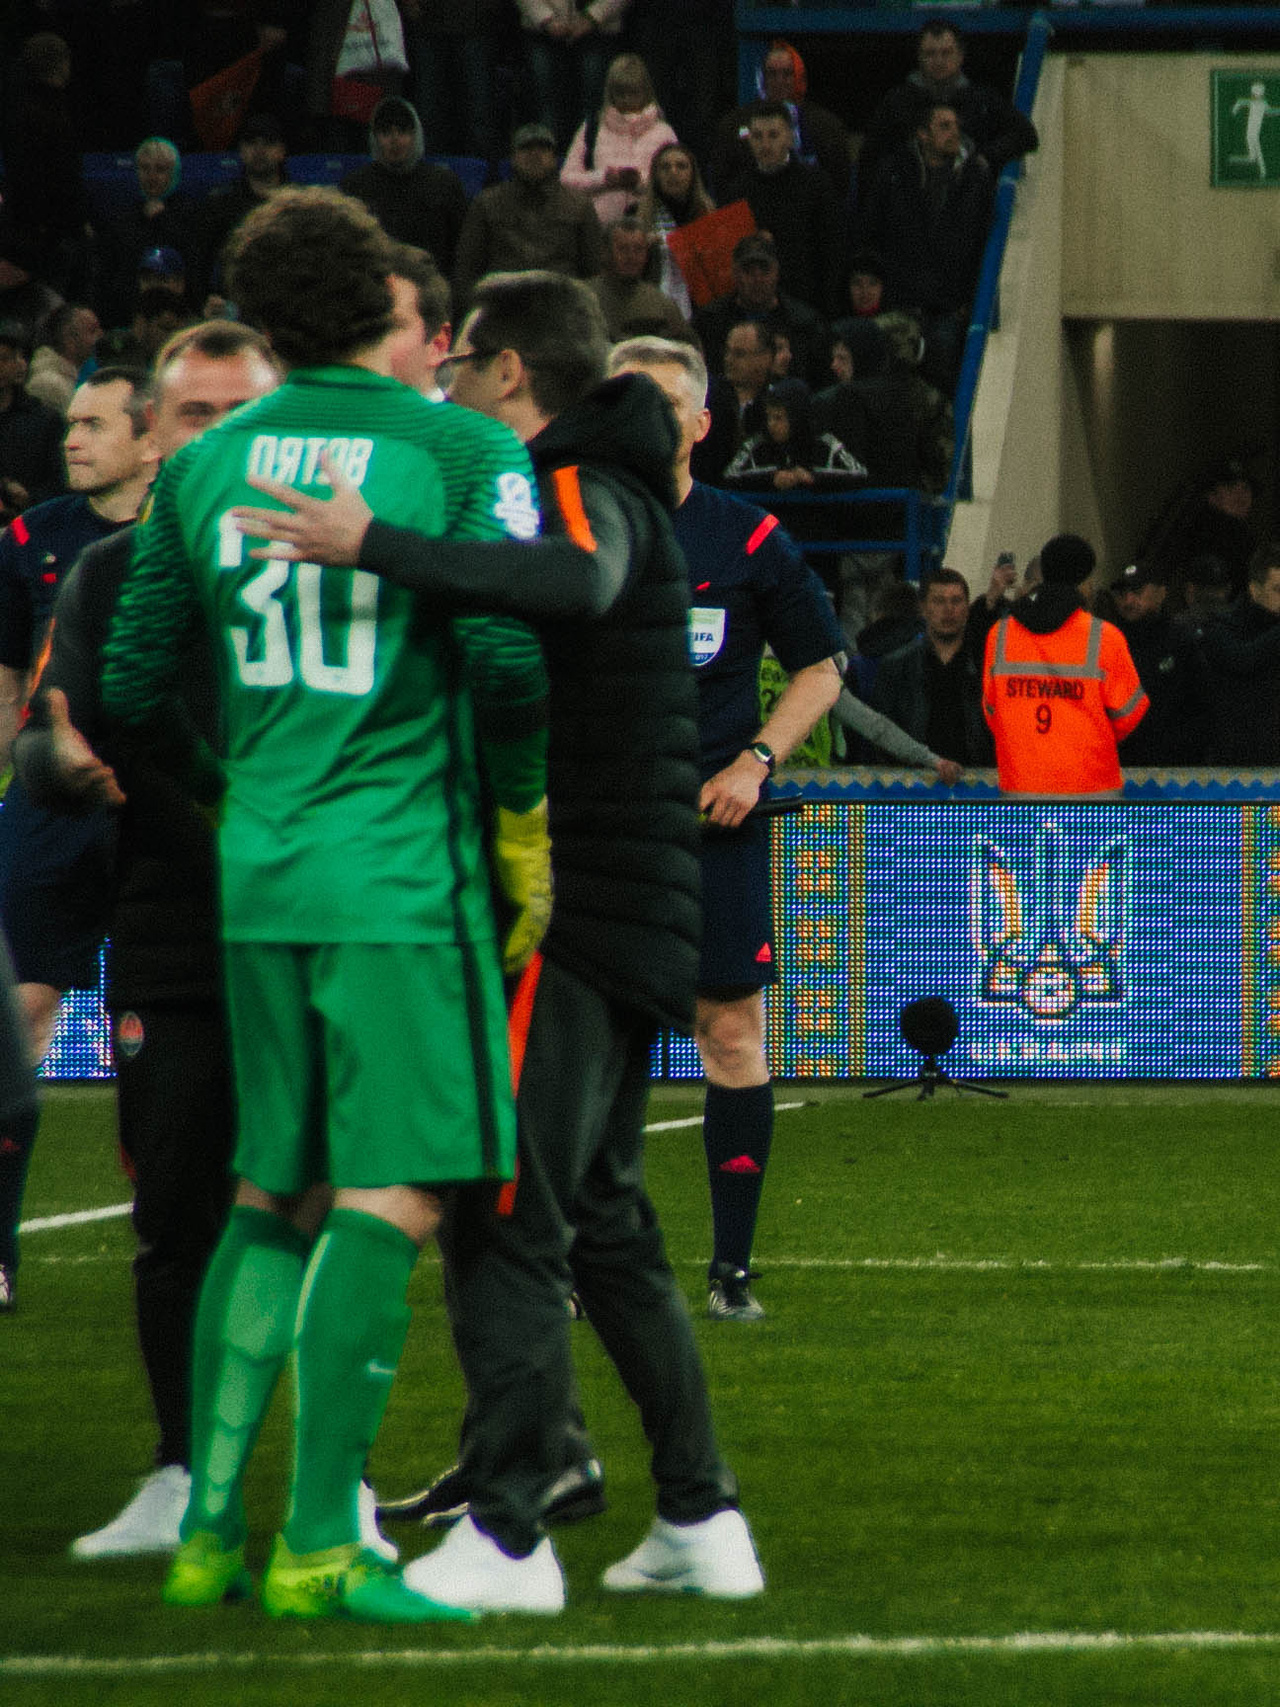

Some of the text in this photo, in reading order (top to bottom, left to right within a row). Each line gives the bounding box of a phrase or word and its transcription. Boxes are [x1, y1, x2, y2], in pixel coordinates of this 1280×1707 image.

[219, 505, 380, 695] 30
[691, 632, 715, 642] IFA
[1006, 678, 1084, 700] STEWARD
[1036, 703, 1052, 735] 9
